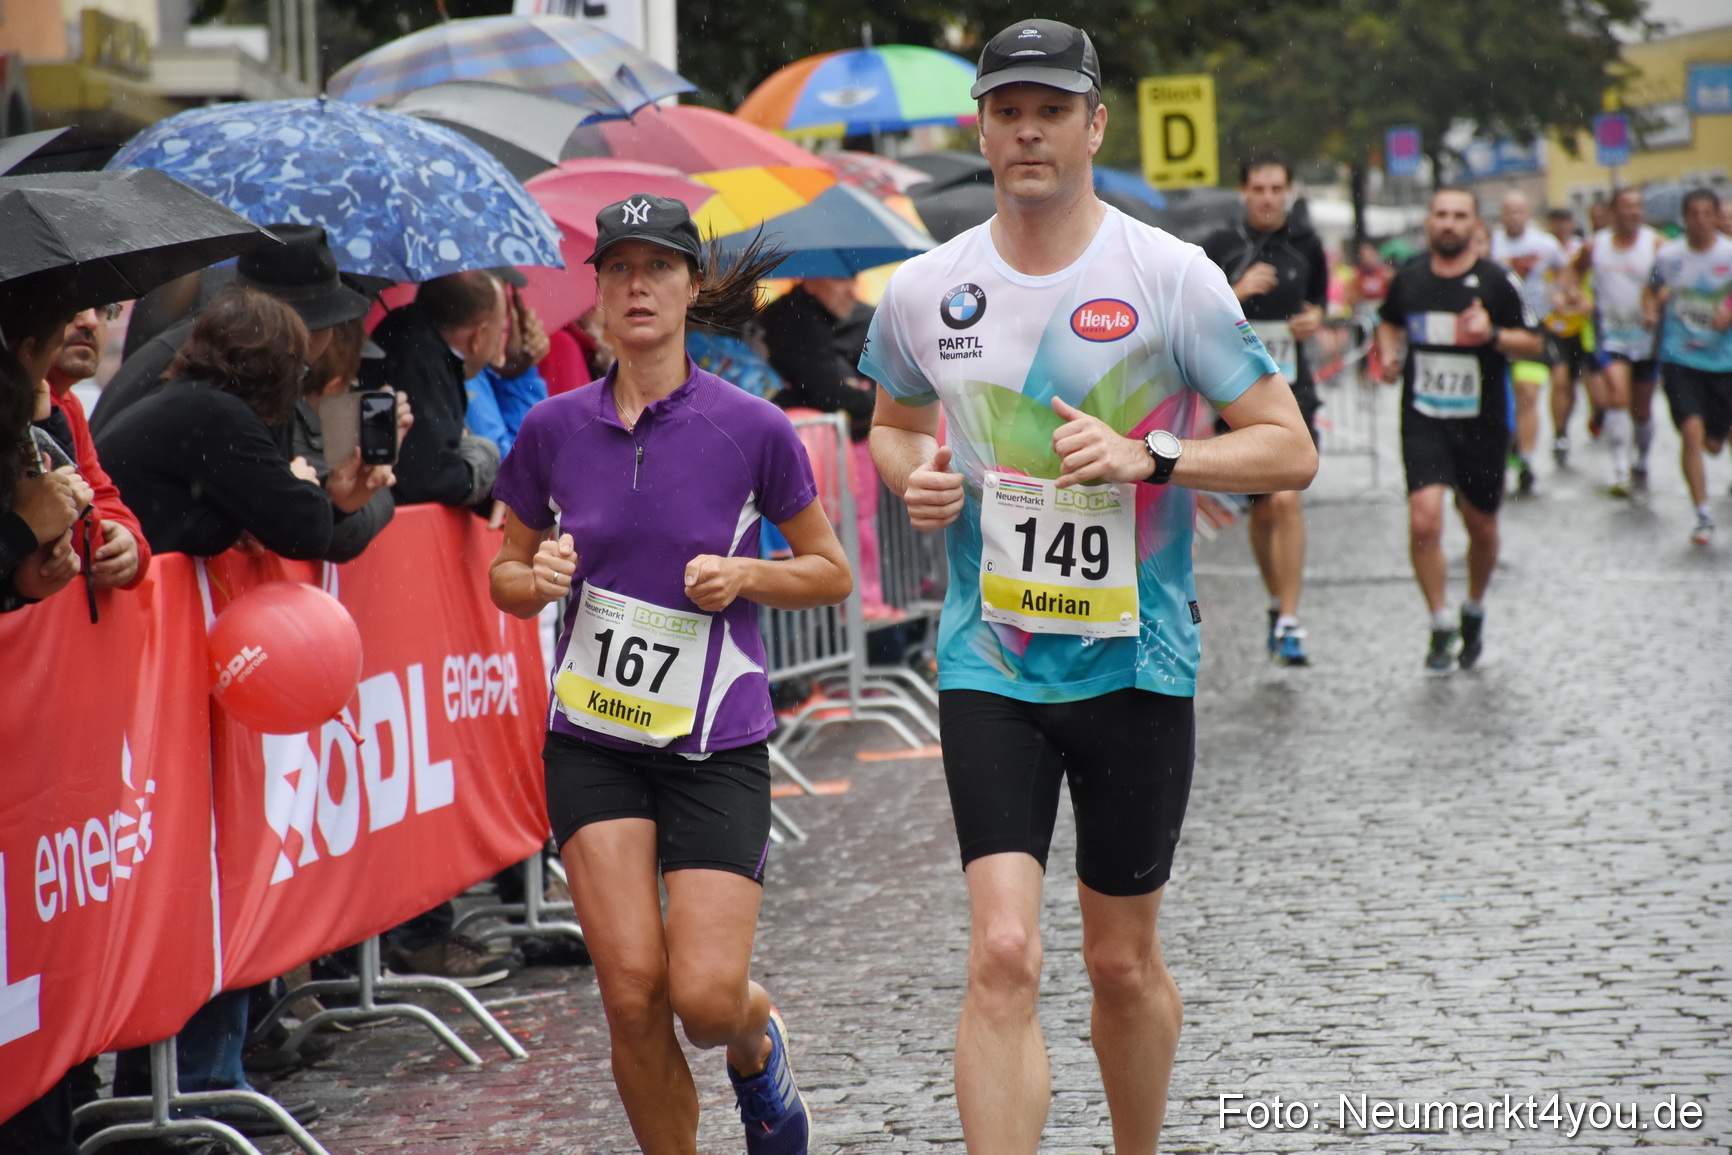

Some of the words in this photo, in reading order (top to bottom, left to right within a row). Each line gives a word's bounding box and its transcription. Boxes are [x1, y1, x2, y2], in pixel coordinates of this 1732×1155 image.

[1163, 112, 1197, 161] D
[622, 199, 651, 224] NY
[946, 284, 984, 299] BMW
[1080, 310, 1130, 331] Hervis
[938, 336, 984, 351] PARTL
[1242, 335, 1259, 346] Ne
[939, 350, 983, 361] Neumarkt
[995, 491, 1045, 506] NeuerMarkt
[1055, 488, 1121, 510] BOCK
[1014, 516, 1110, 581] 149
[987, 561, 993, 571] C
[584, 600, 625, 621] NeuerMarkt
[1021, 589, 1090, 617] Adrian
[633, 606, 699, 636] BOCK
[237, 652, 268, 683] energie
[566, 661, 574, 671] A
[594, 628, 680, 694] 167
[587, 690, 652, 727] Kathrin
